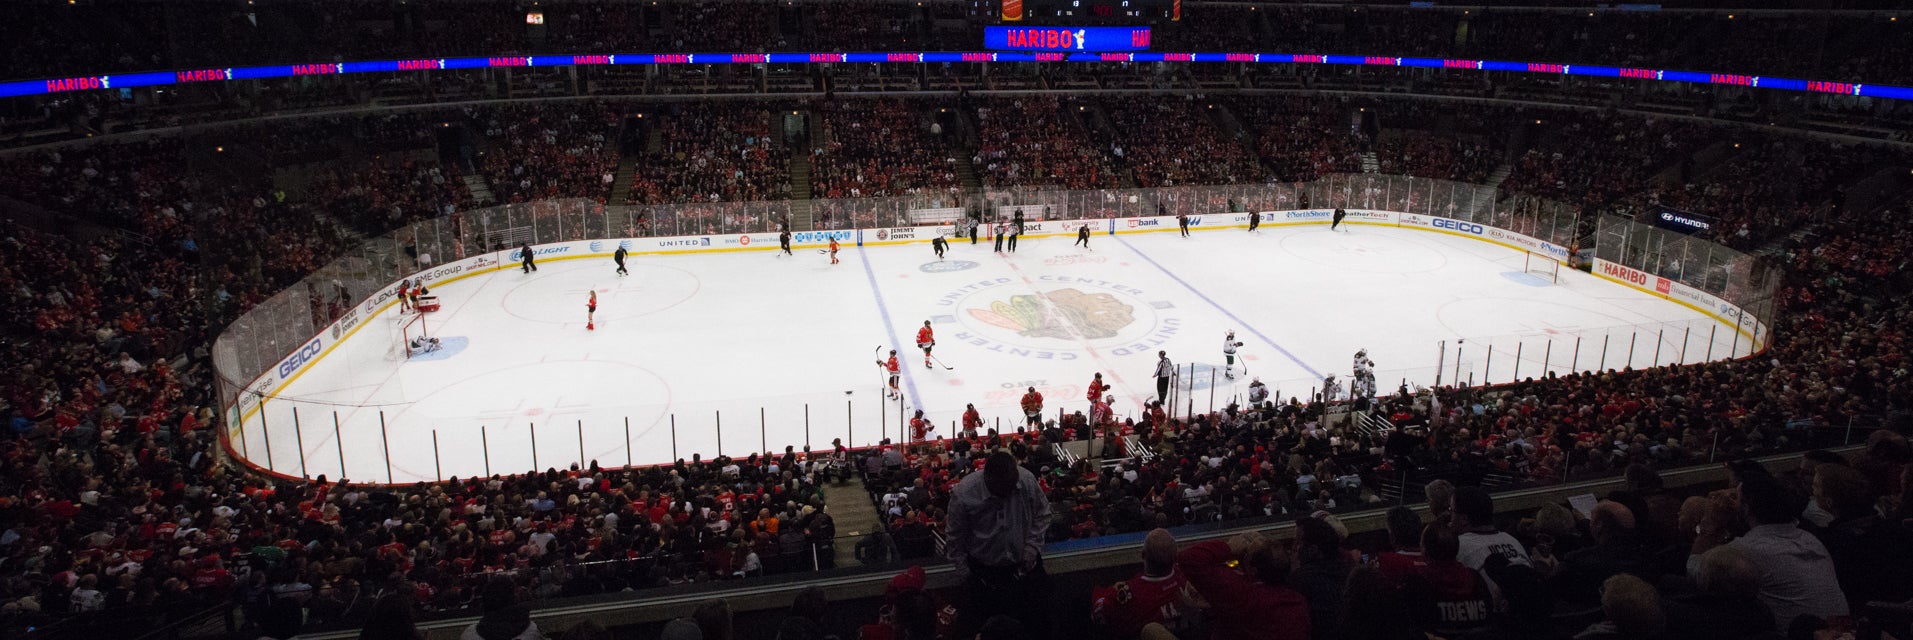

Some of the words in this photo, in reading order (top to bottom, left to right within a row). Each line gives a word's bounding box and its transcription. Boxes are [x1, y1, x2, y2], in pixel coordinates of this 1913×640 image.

[1007, 29, 1073, 49] HARIBO
[573, 55, 608, 65] HARIBO
[654, 54, 687, 64] HARIBO
[731, 53, 765, 63] HARIBO
[809, 53, 842, 63] HARIBO
[887, 53, 919, 62] HARIBO
[962, 52, 993, 61] HARIBO
[1101, 53, 1130, 62] HARIBO
[1164, 53, 1193, 62] HARIBO
[1227, 53, 1255, 62] HARIBO
[1294, 54, 1324, 63] HARIBO
[1365, 56, 1397, 65] HARIBO
[397, 60, 438, 70] HARIBO
[489, 57, 526, 67] HARIBO
[1444, 59, 1477, 69] HARIBO
[292, 63, 335, 75] HARIBO
[1528, 63, 1563, 73] HARIBO
[177, 69, 223, 82] HARIBO
[1620, 68, 1657, 80] HARIBO
[47, 77, 98, 92] HARIBO
[1711, 73, 1751, 86] HARIBO
[1807, 81, 1852, 95] HARIBO
[1290, 210, 1330, 218] NorthShore
[1139, 218, 1159, 226] bank
[1432, 218, 1483, 235] GEICO
[1674, 215, 1709, 230] HYUNDAI
[659, 239, 698, 247] UNITED
[1516, 237, 1536, 248] MOTORS
[538, 246, 570, 255] LIGHT
[434, 264, 462, 279] Group
[1603, 262, 1647, 286] HARIBO
[937, 276, 1012, 306] UNITED
[1039, 274, 1145, 295] CENTER
[1671, 284, 1700, 302] financial
[1700, 294, 1716, 308] bank
[1111, 317, 1181, 357] UNITED
[954, 331, 1079, 361] CENTER
[279, 338, 321, 379] GEICO
[1436, 599, 1488, 623] TOEWS
